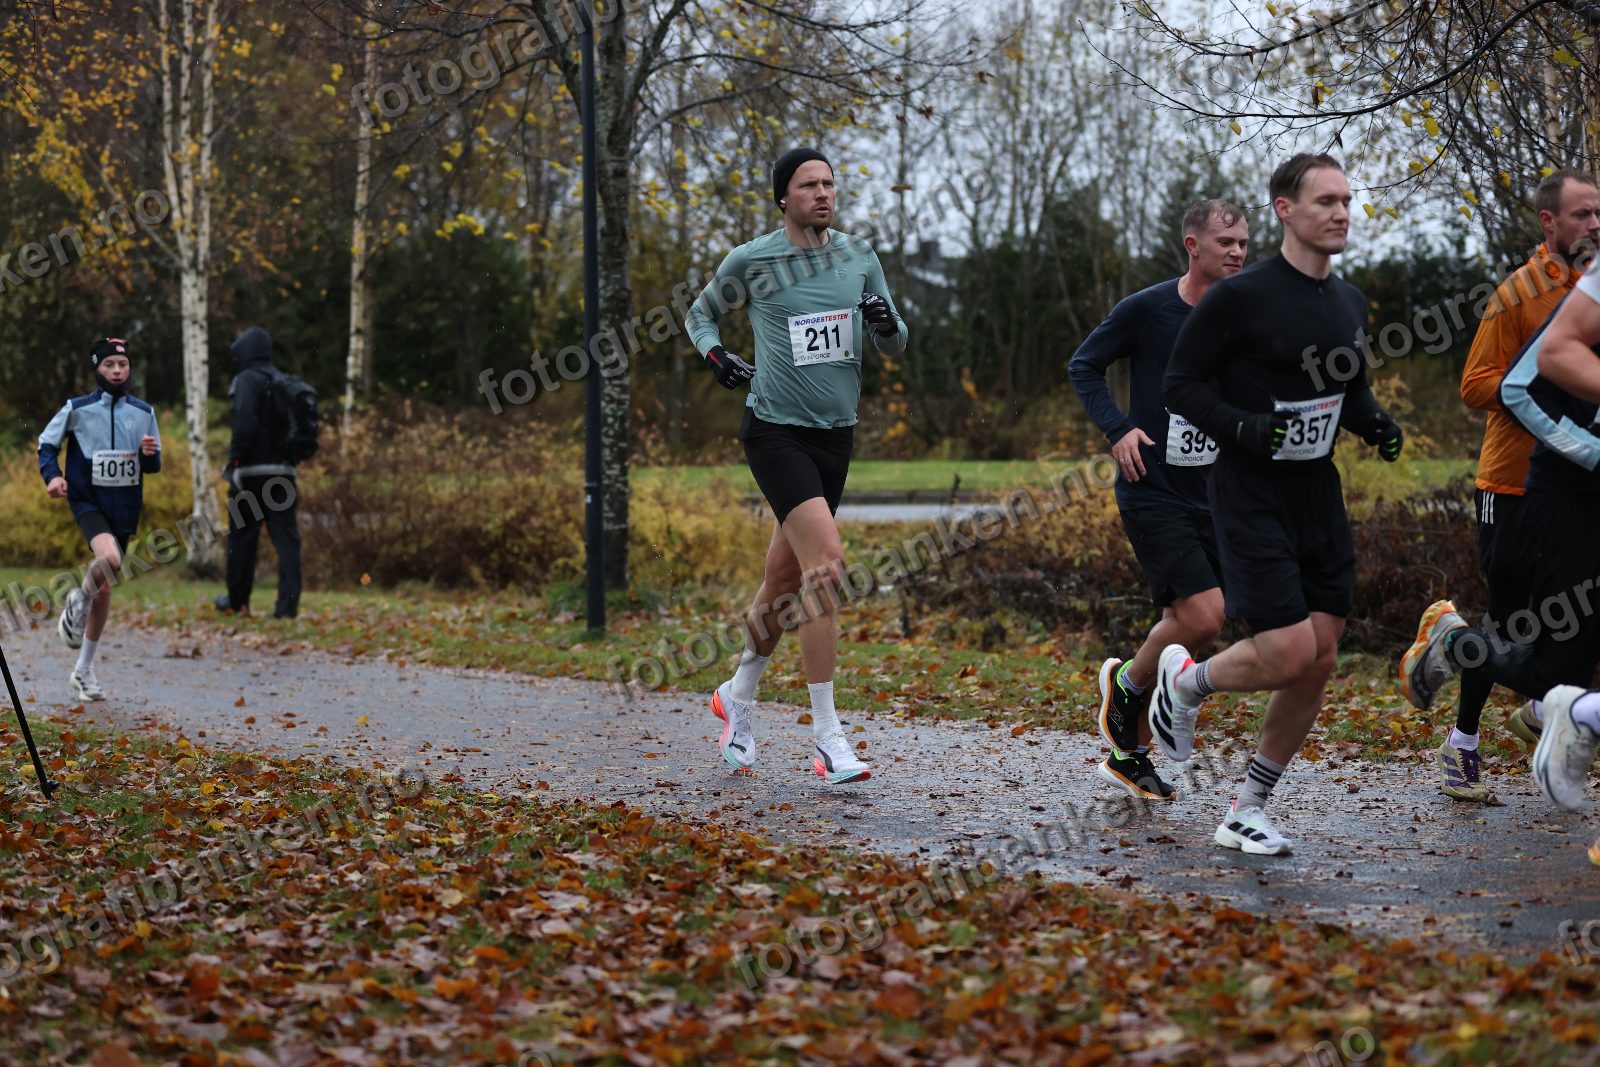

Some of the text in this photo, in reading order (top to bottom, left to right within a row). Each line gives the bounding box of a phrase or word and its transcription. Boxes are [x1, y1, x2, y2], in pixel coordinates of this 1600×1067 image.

[794, 313, 849, 326] NORGESTESTEN
[805, 324, 840, 352] 211
[1290, 412, 1332, 446] 357
[98, 460, 136, 478] 1013
